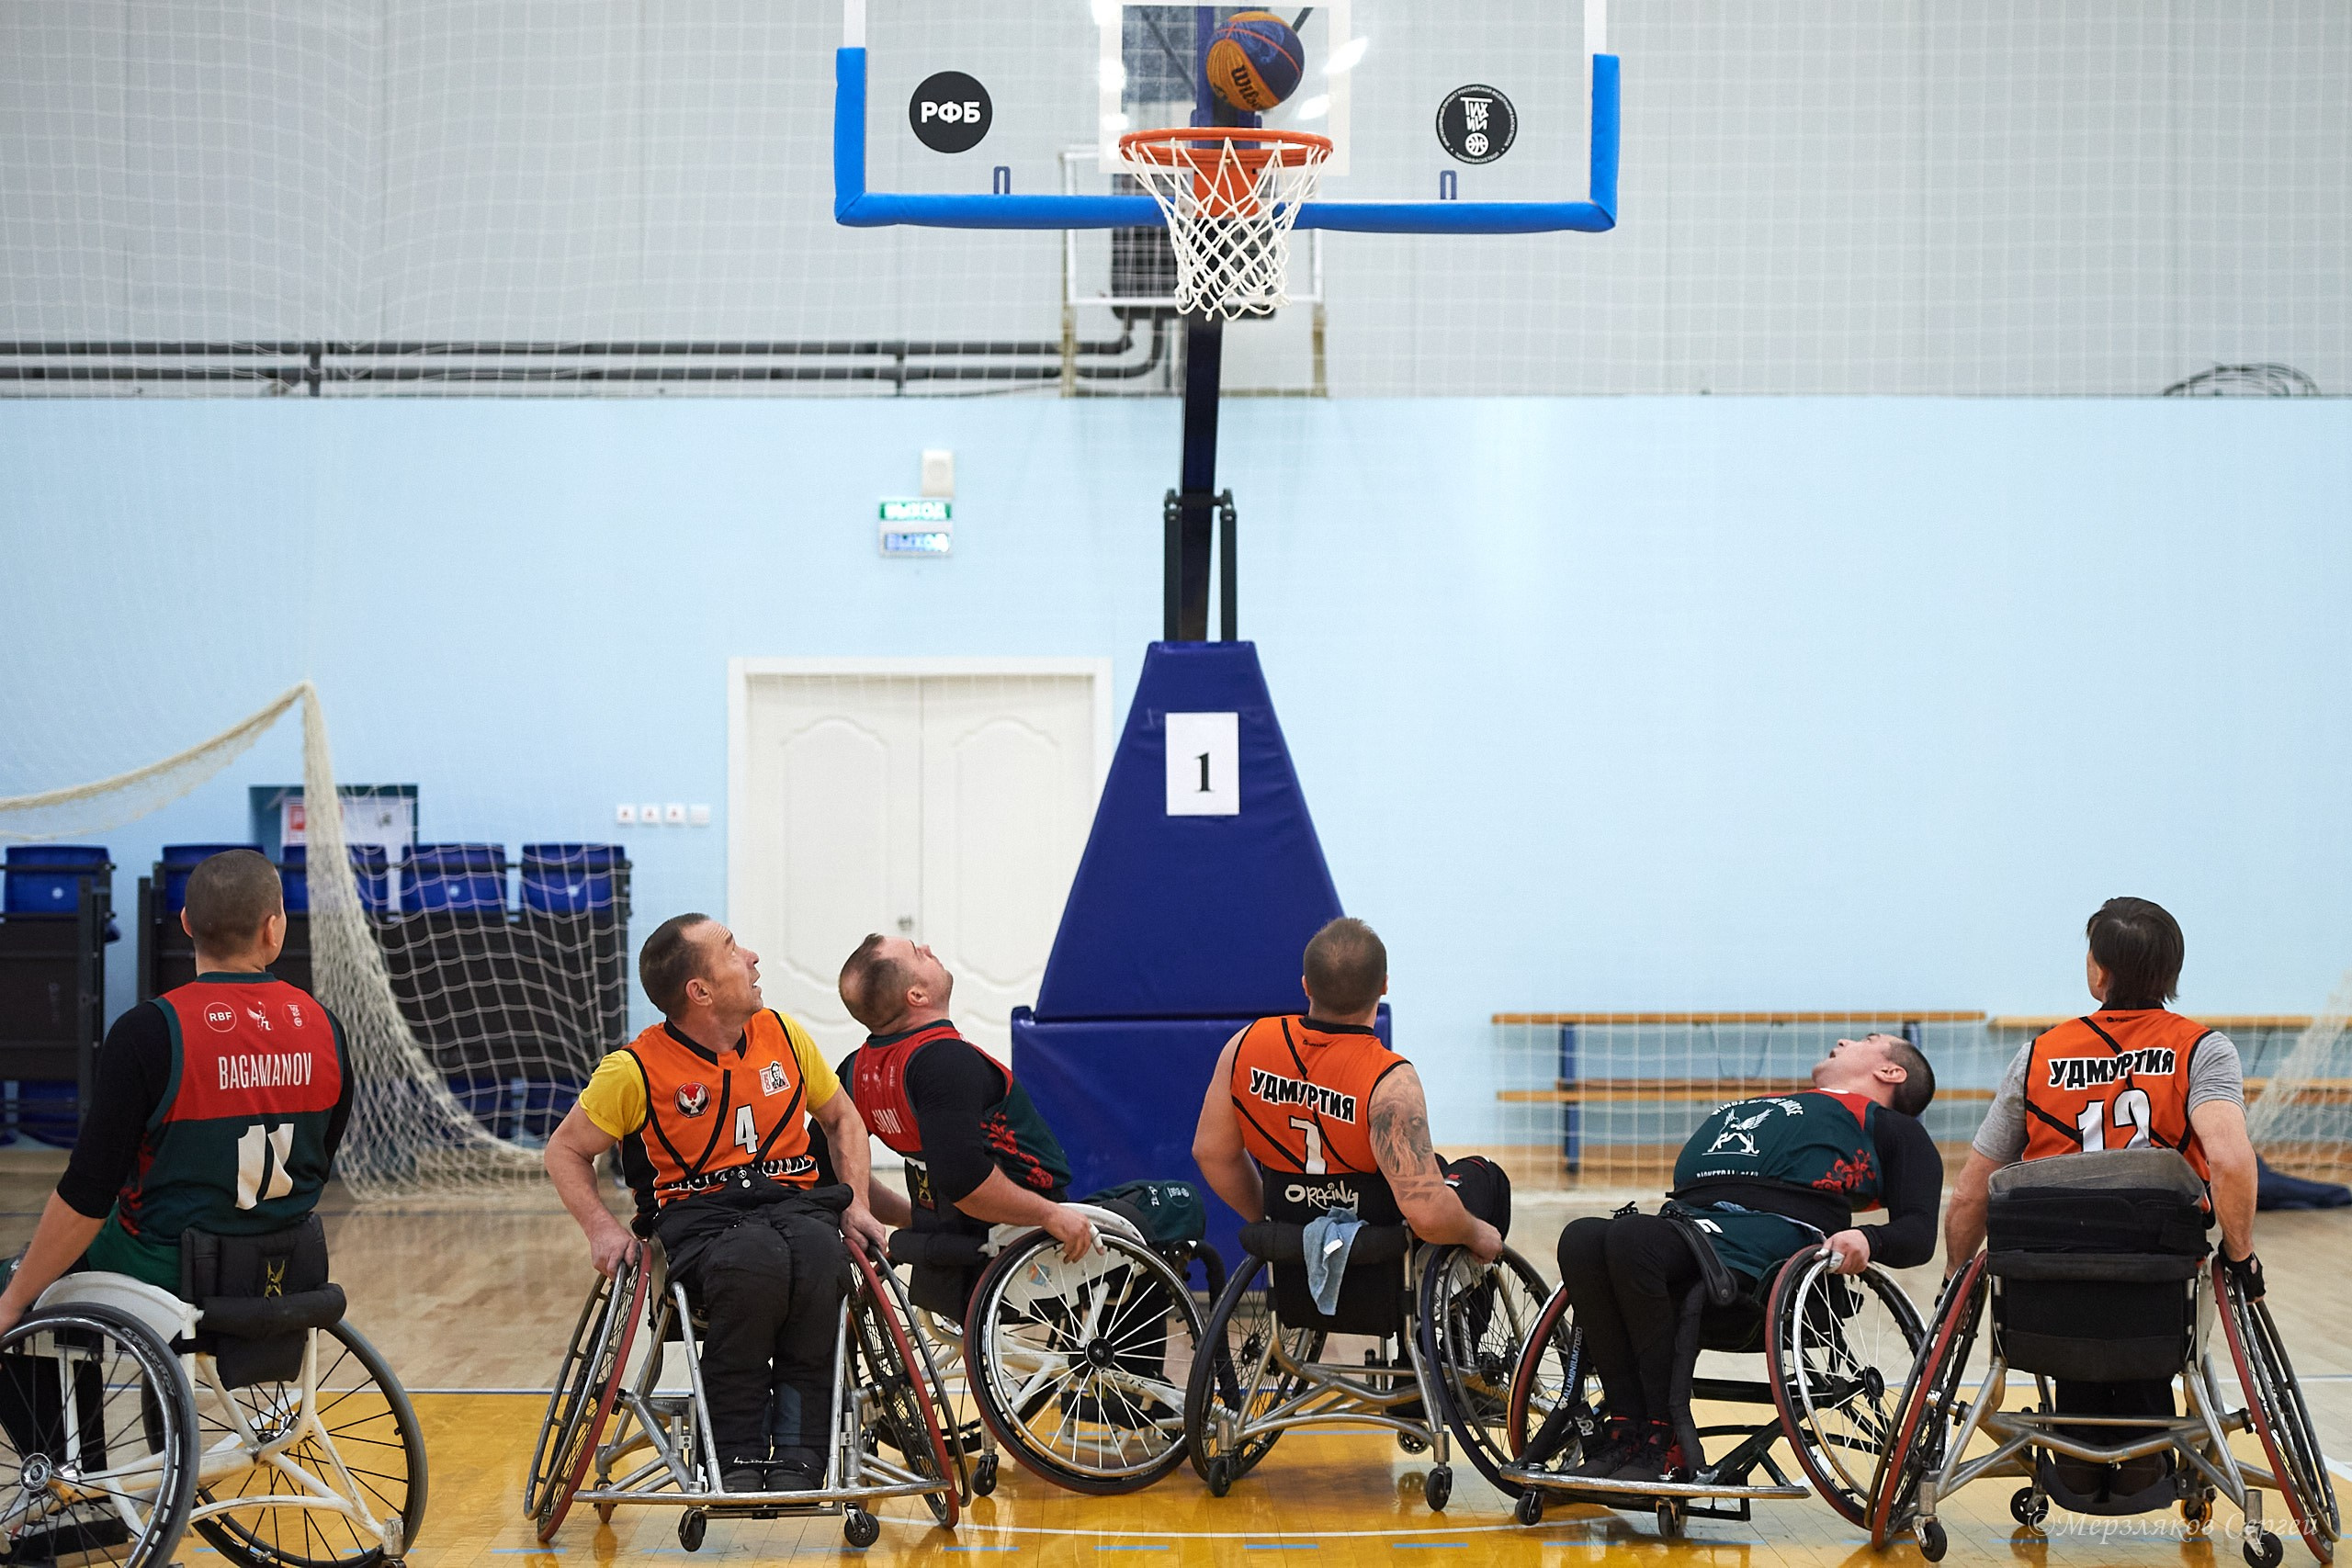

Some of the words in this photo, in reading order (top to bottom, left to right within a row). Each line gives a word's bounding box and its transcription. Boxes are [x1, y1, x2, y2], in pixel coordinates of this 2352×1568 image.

[921, 101, 980, 123] РФБ
[1194, 752, 1215, 793] 1
[209, 1011, 232, 1021] RBF
[218, 1052, 311, 1090] BAGAMANOV
[2048, 1047, 2176, 1090] УДМУРТИЯ
[1250, 1066, 1356, 1124] УДМУРТИЯ
[735, 1103, 759, 1155] 4
[2075, 1088, 2152, 1152] 12
